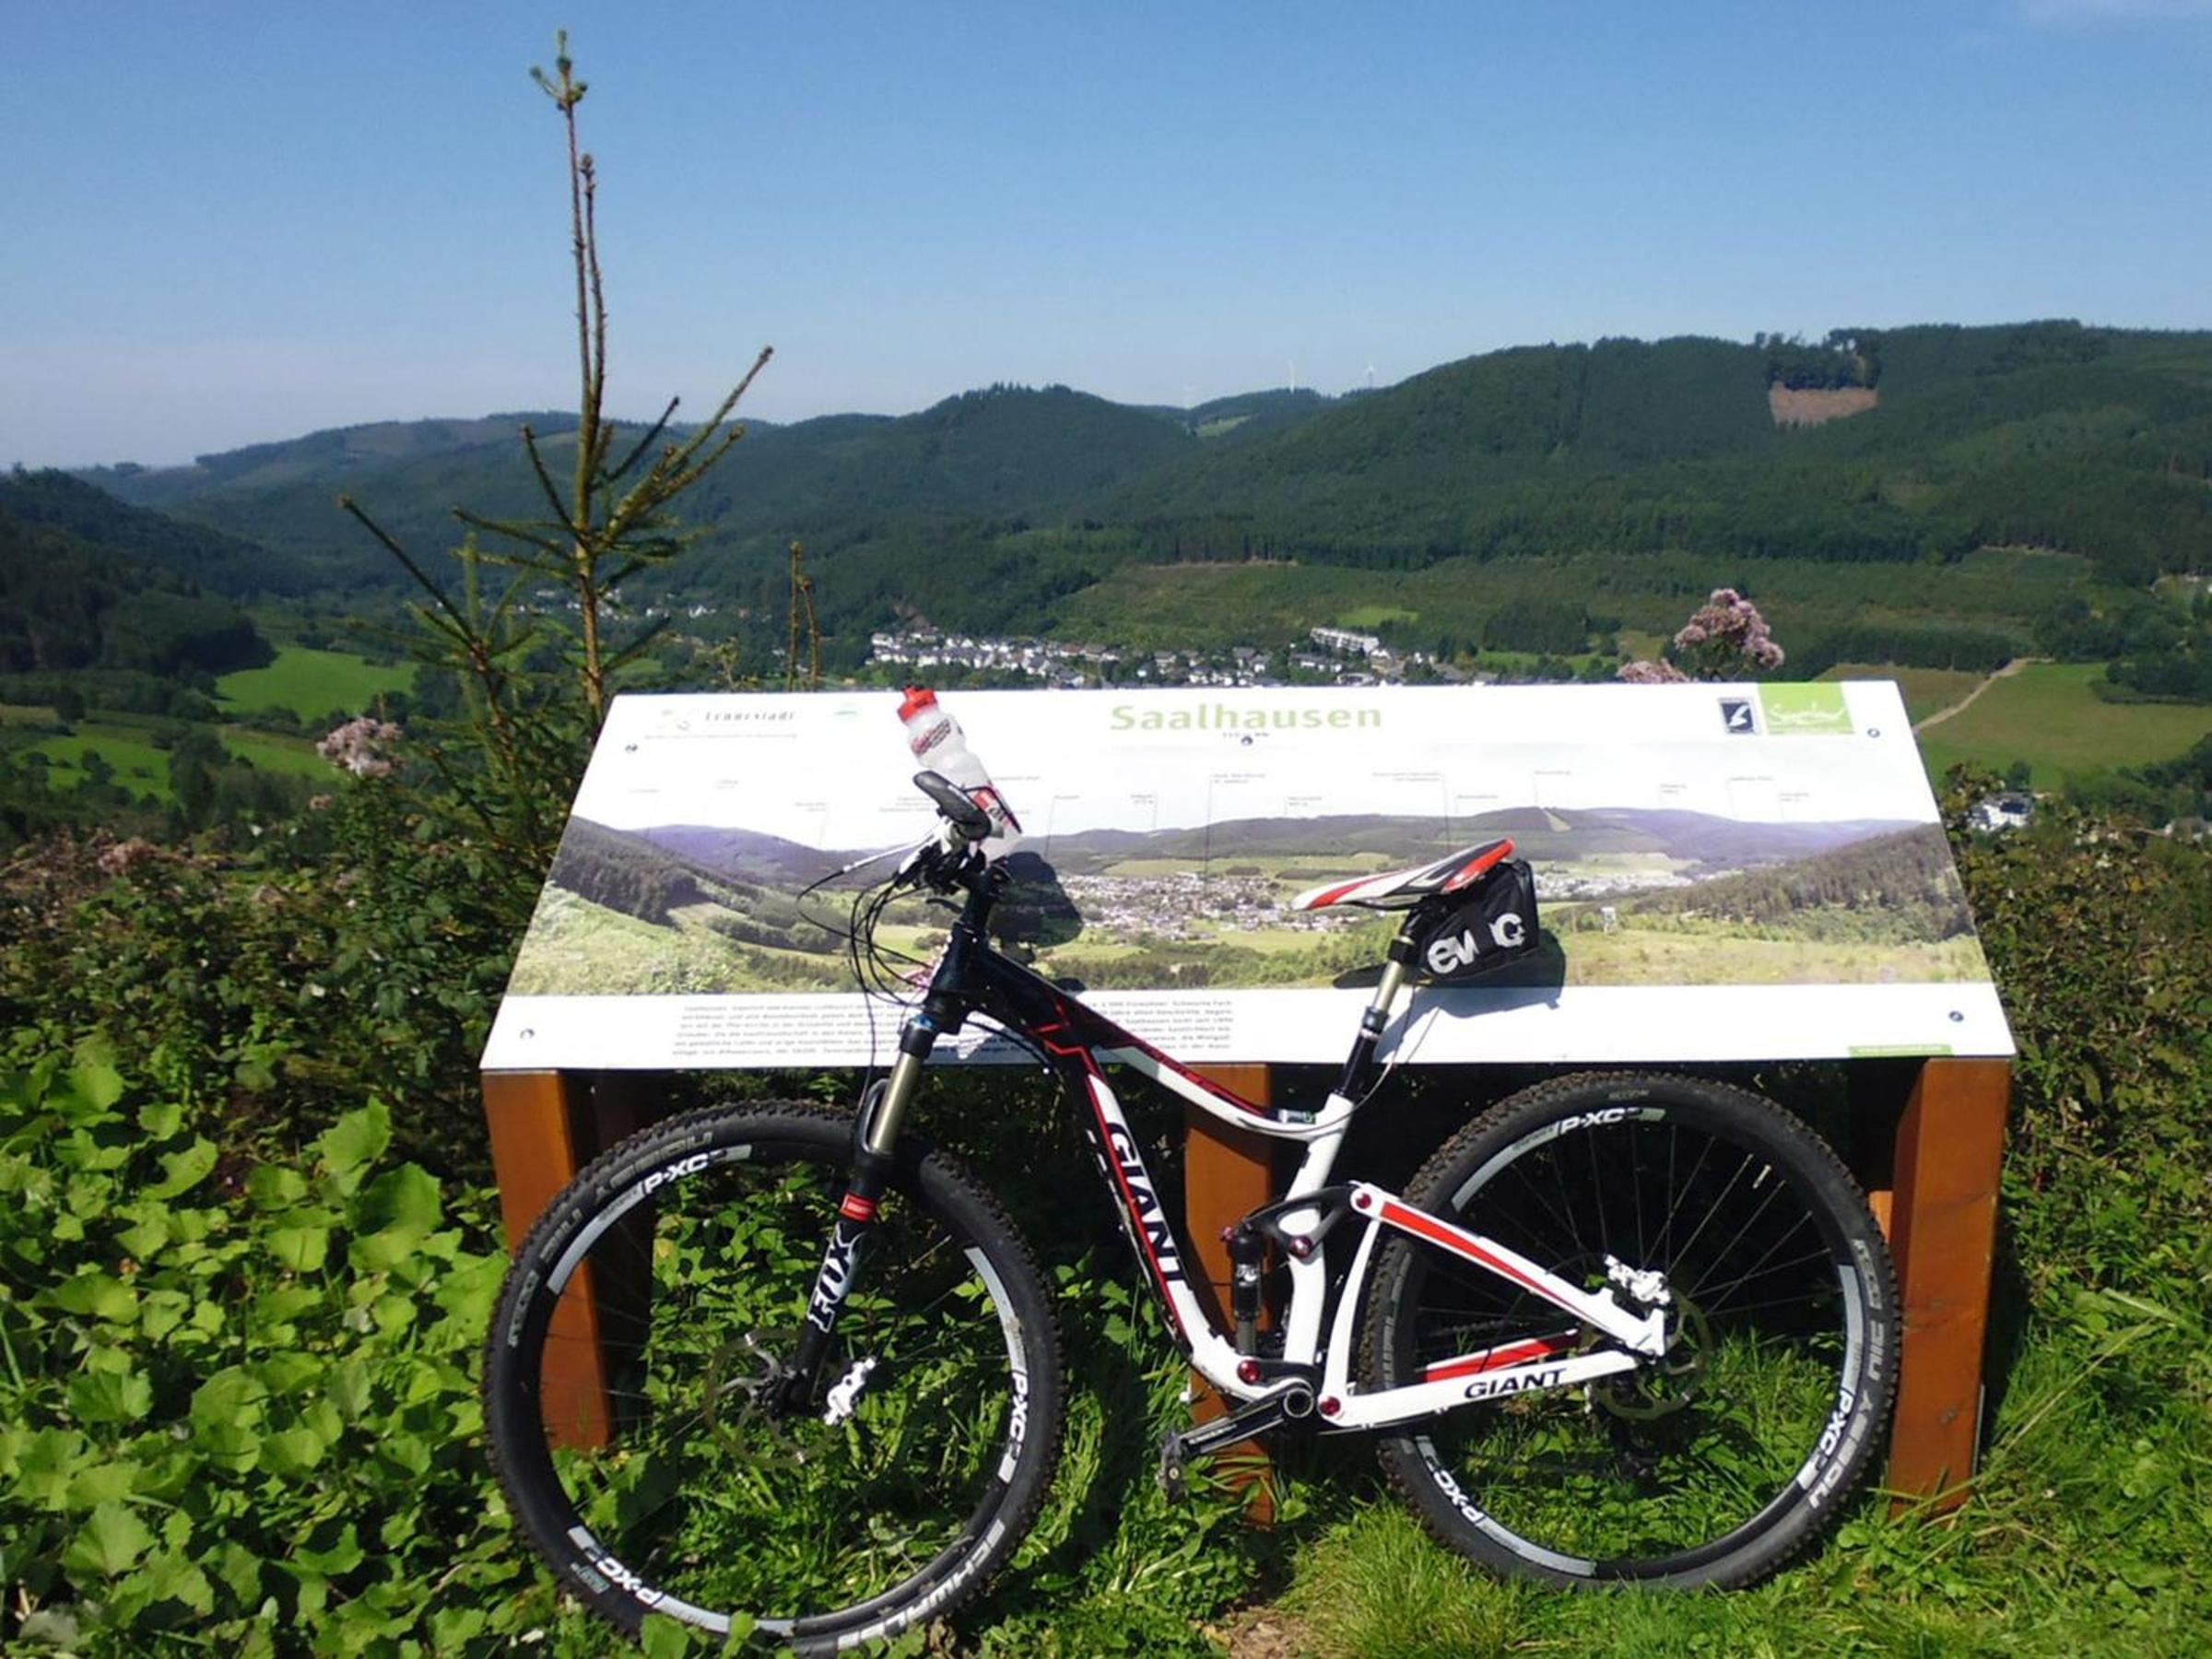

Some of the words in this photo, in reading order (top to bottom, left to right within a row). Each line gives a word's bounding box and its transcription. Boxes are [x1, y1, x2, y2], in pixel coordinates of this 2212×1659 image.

[1110, 702, 1382, 731] Saalhausen
[1106, 1122, 1185, 1281] GIANT
[806, 1220, 867, 1333] FOX
[1464, 1368, 1567, 1399] GIANT
